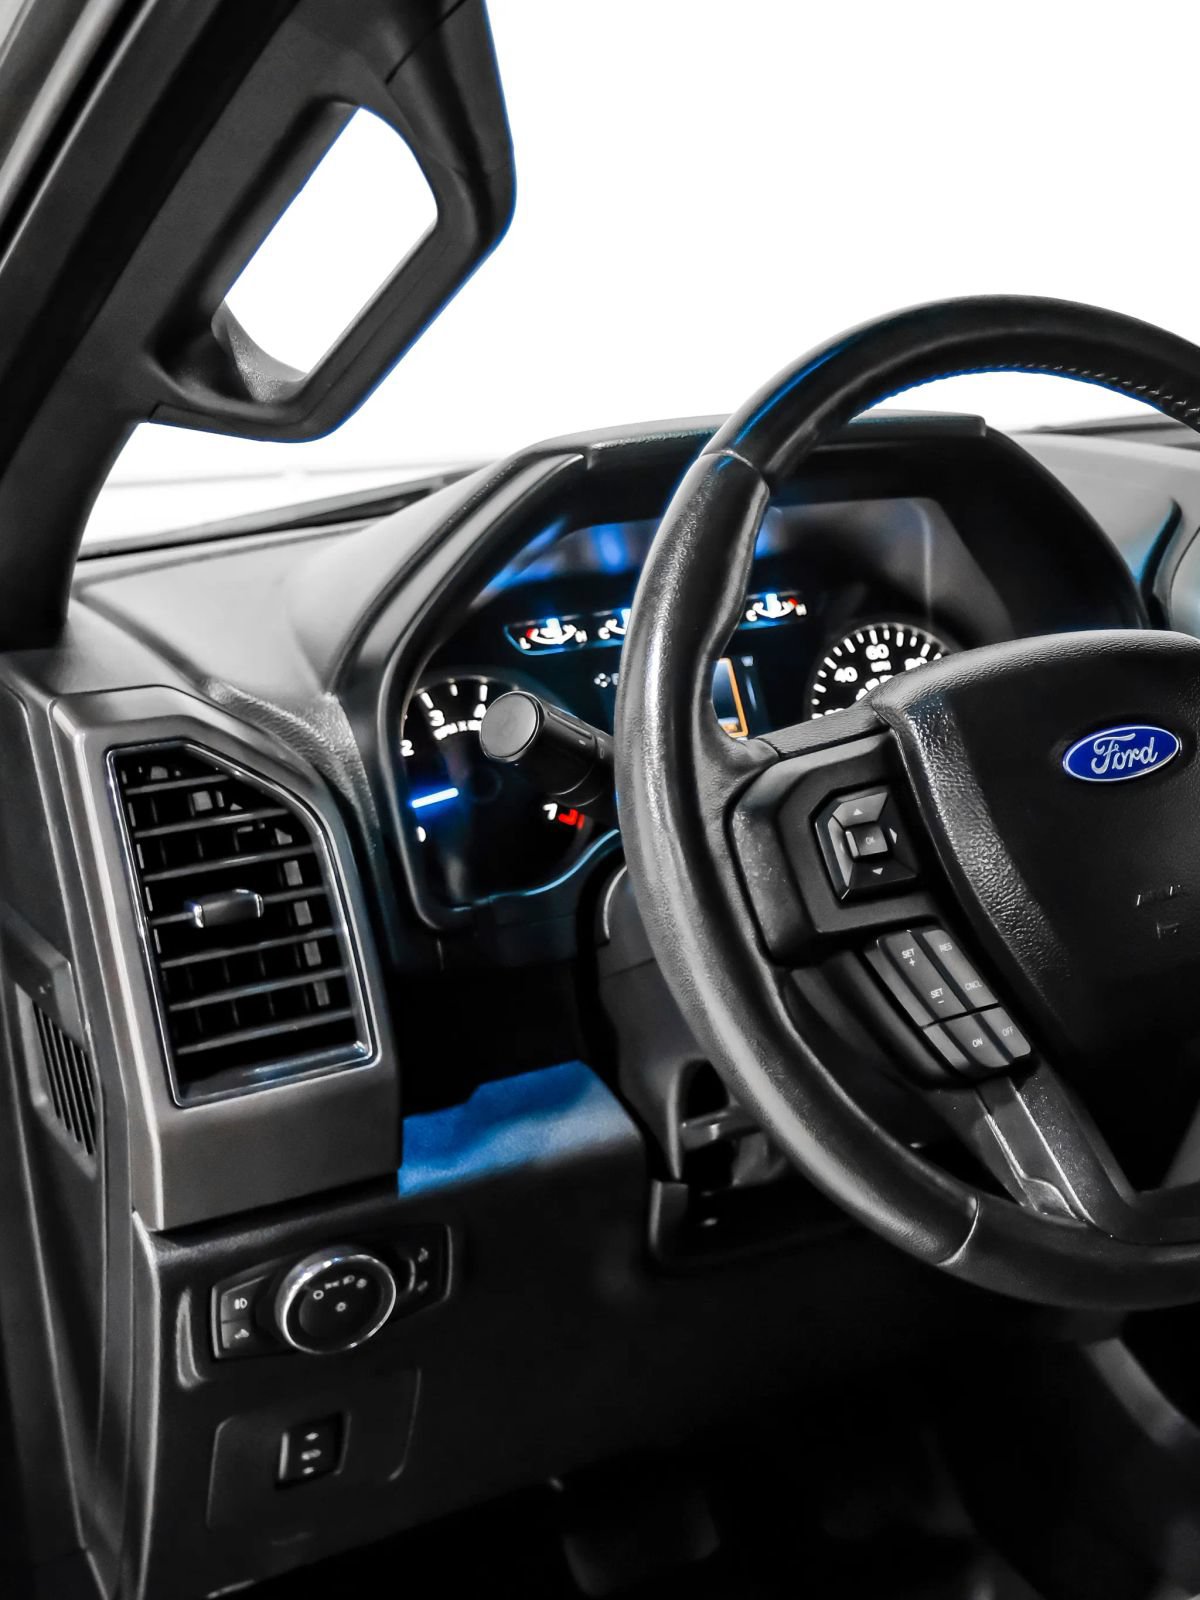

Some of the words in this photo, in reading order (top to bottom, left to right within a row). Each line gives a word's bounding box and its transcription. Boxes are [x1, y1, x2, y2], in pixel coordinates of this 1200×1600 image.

[865, 643, 890, 661] 60
[834, 666, 858, 683] 40
[428, 709, 446, 727] 3
[401, 739, 415, 757] 2
[1091, 733, 1158, 774] Ford
[543, 802, 557, 820] 7
[902, 948, 915, 959] SET
[939, 942, 953, 953] RES
[965, 980, 983, 991] CNCL
[930, 988, 944, 999] SET
[1002, 1026, 1014, 1037] OFF
[972, 1038, 984, 1048] ON
